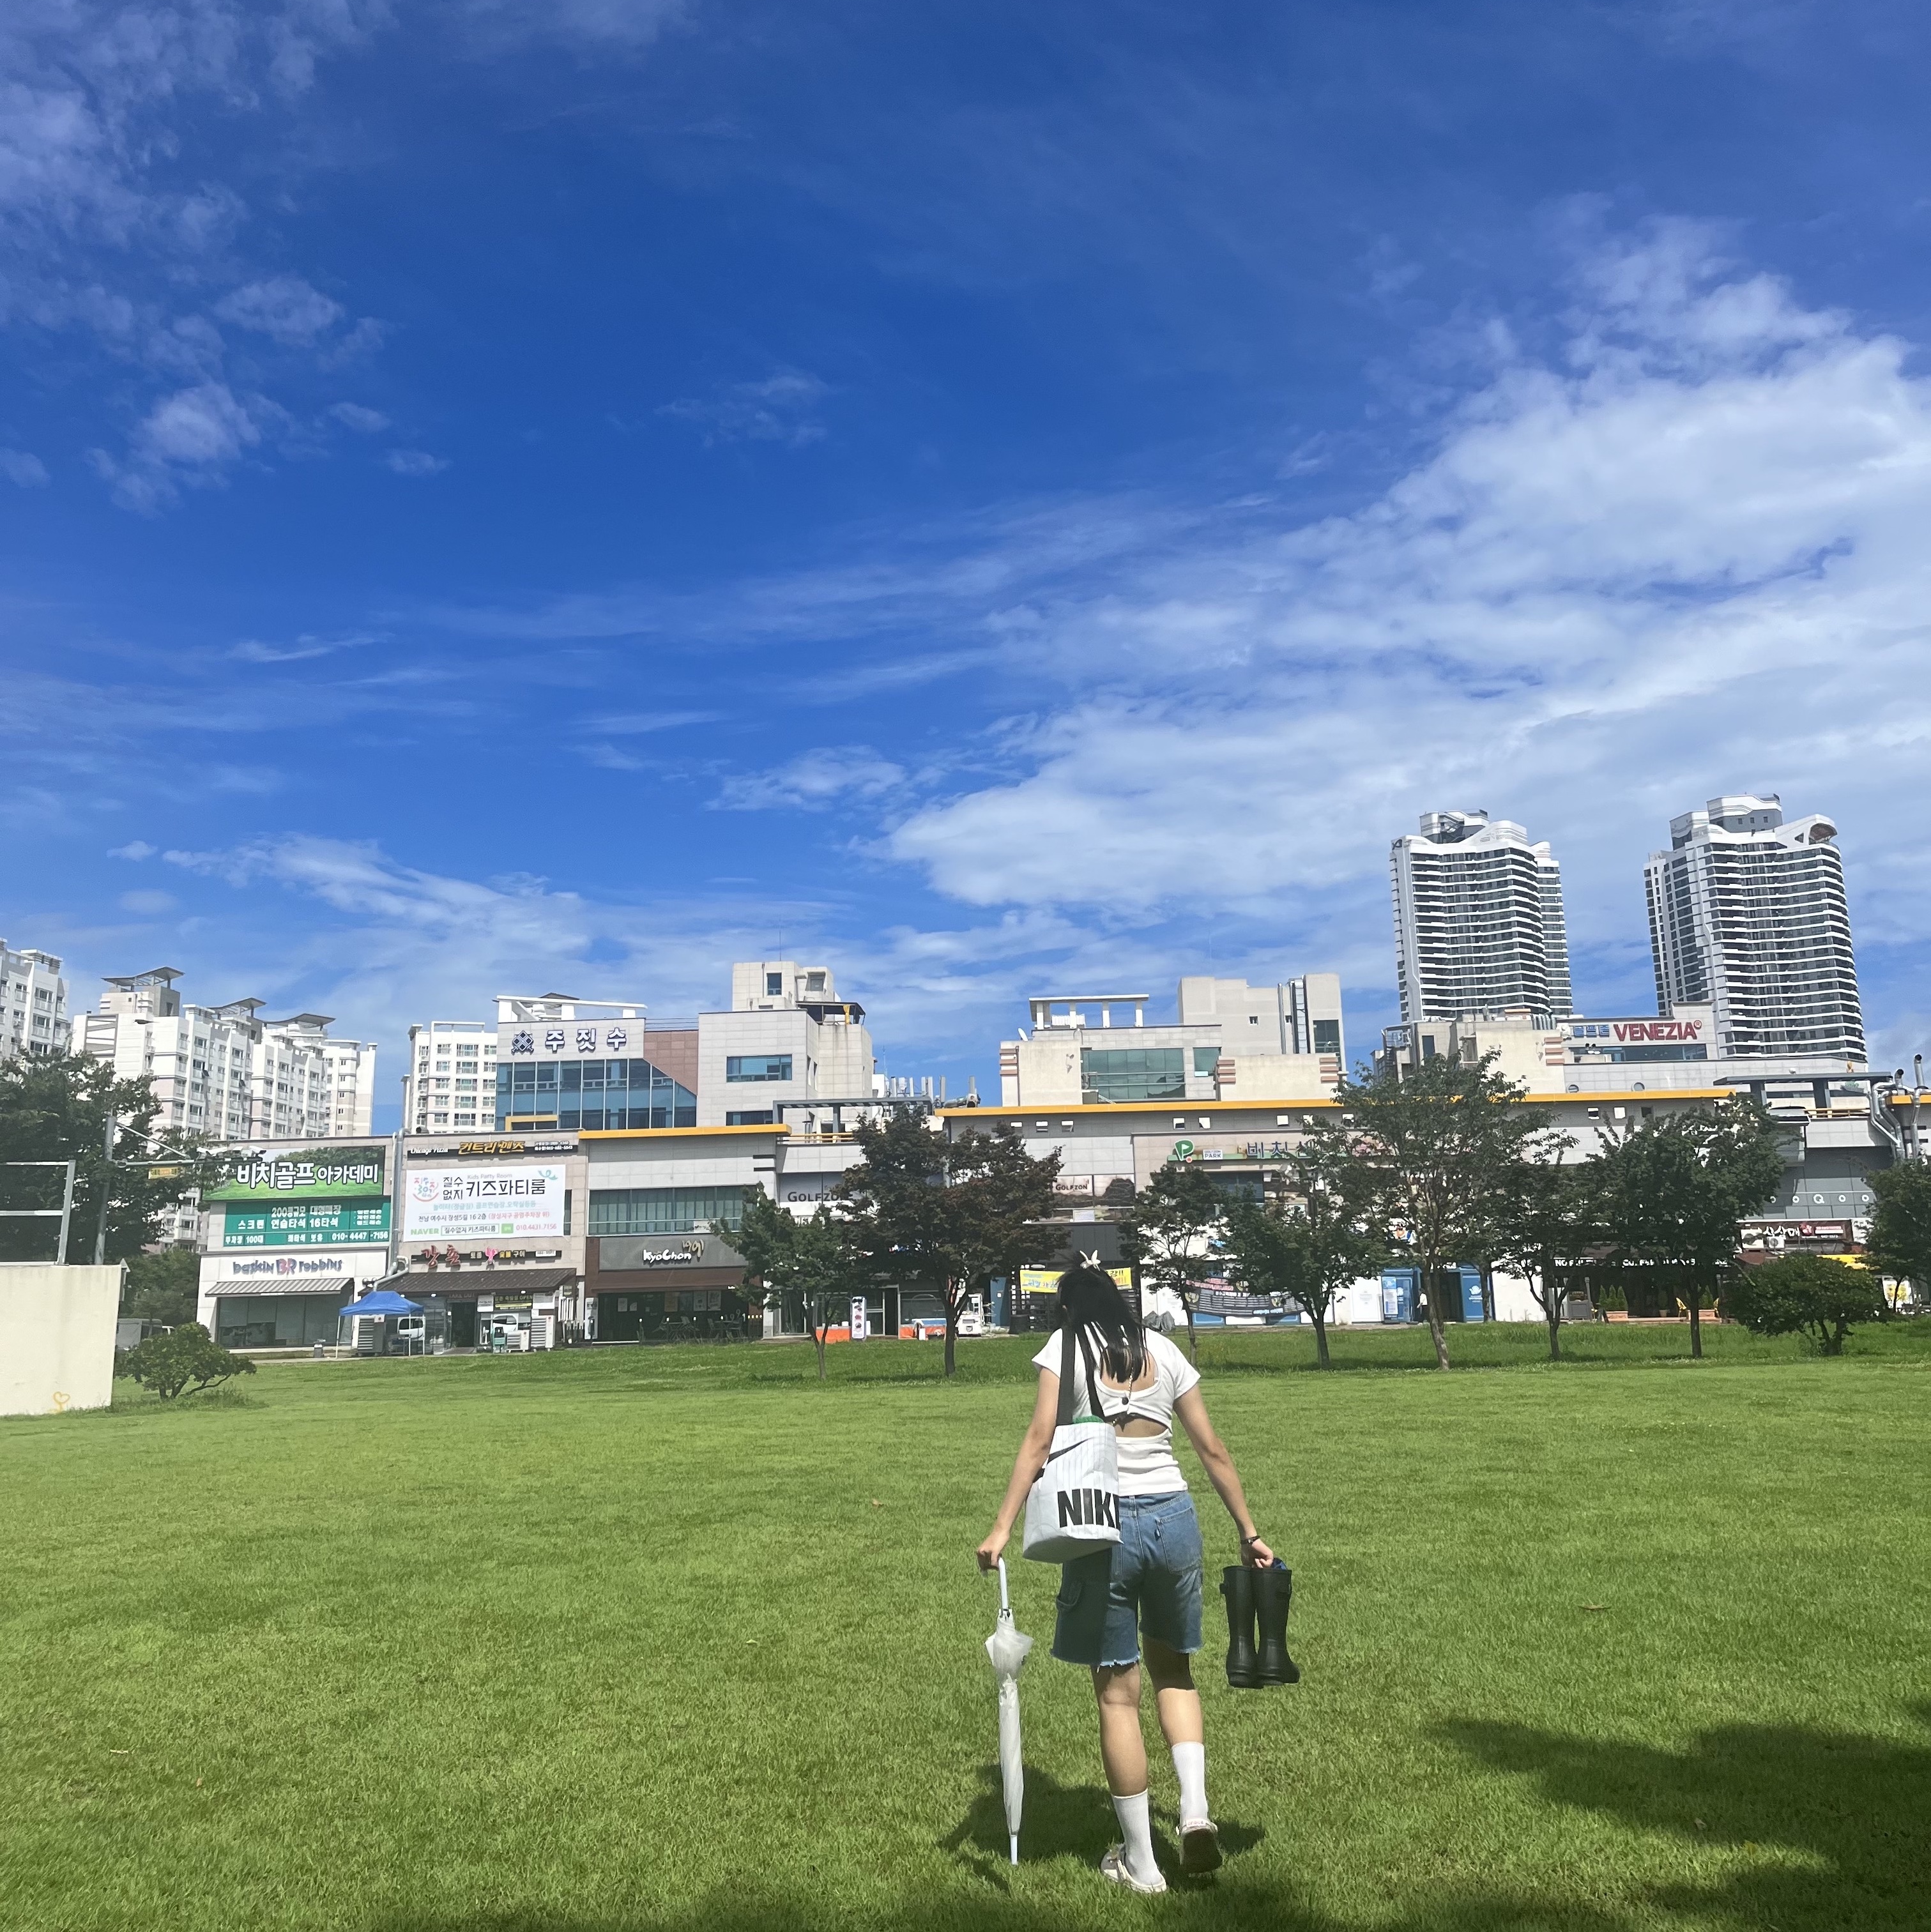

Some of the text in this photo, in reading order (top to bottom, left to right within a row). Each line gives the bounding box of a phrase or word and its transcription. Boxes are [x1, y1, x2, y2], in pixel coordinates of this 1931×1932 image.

[1614, 1022, 1698, 1041] VENEZIA
[236, 1162, 379, 1189] 비치골프 아카데미
[443, 1176, 463, 1188] 질수
[443, 1189, 462, 1201] 없지
[466, 1179, 546, 1197] 키즈파티룸
[271, 1219, 307, 1229] 연습타석
[309, 1217, 339, 1228] 16타석
[643, 1249, 692, 1263] KyoChon
[233, 1258, 343, 1275] baskin BR robbins
